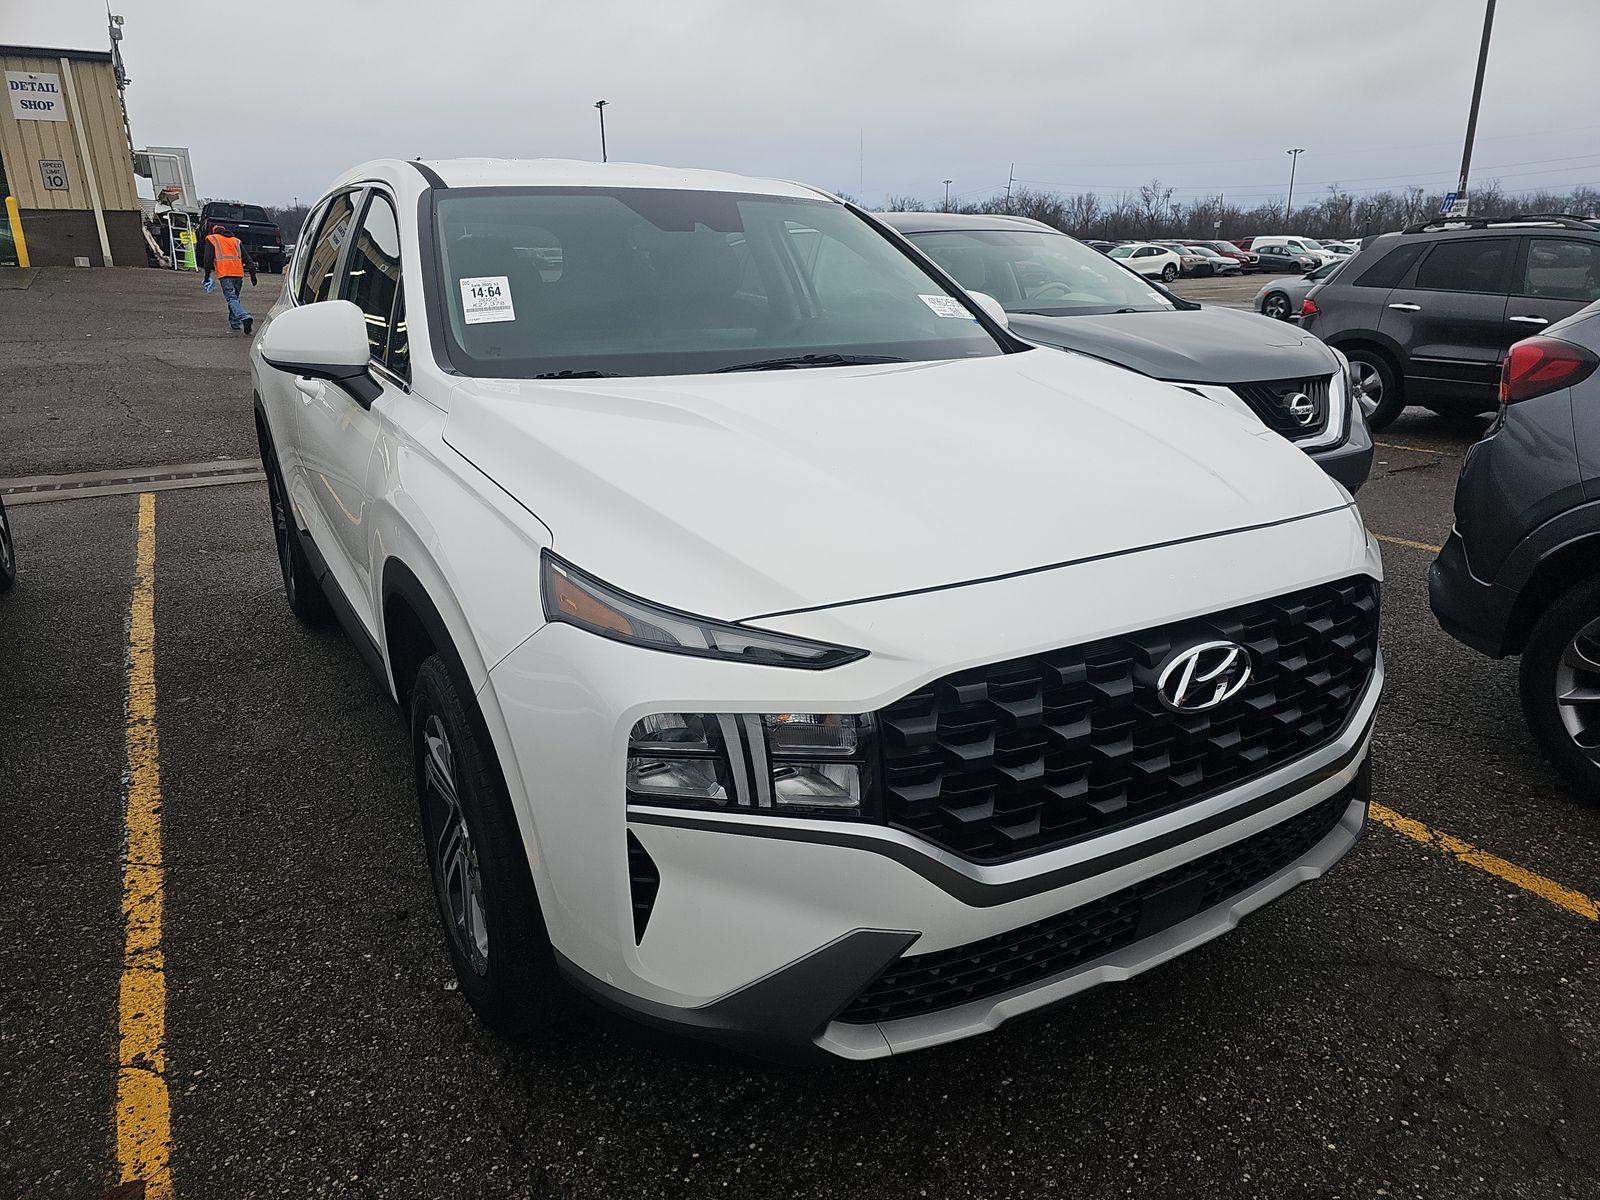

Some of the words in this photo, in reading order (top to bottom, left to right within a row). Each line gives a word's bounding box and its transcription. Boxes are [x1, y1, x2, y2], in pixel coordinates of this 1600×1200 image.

[9, 81, 59, 93] DETAIL
[20, 100, 55, 111] SHOP
[47, 176, 63, 187] 10
[470, 287, 501, 298] 14:64
